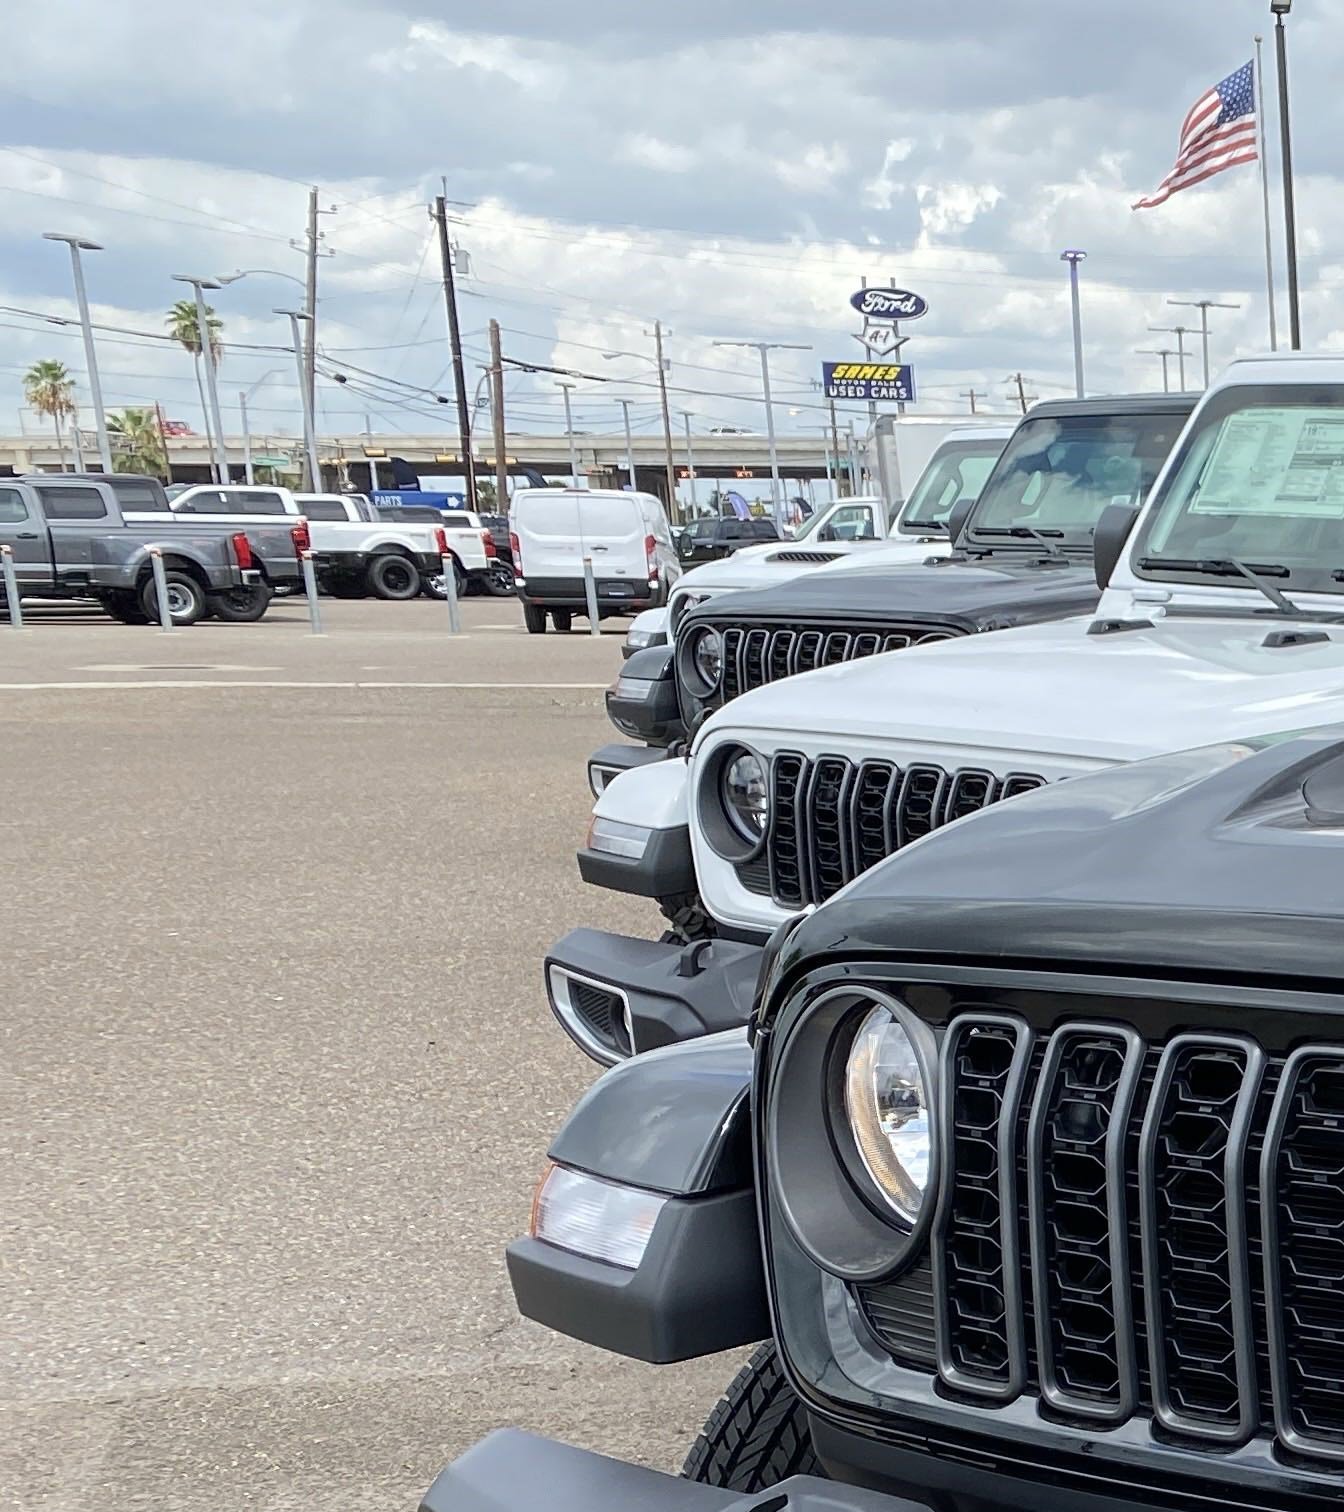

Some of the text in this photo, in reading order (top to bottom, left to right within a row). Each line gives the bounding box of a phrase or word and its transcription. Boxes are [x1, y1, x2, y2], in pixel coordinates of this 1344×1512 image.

[860, 290, 917, 315] Ford
[831, 364, 902, 381] SAMES
[828, 385, 908, 399] USED CARS
[374, 495, 403, 507] PARTS
